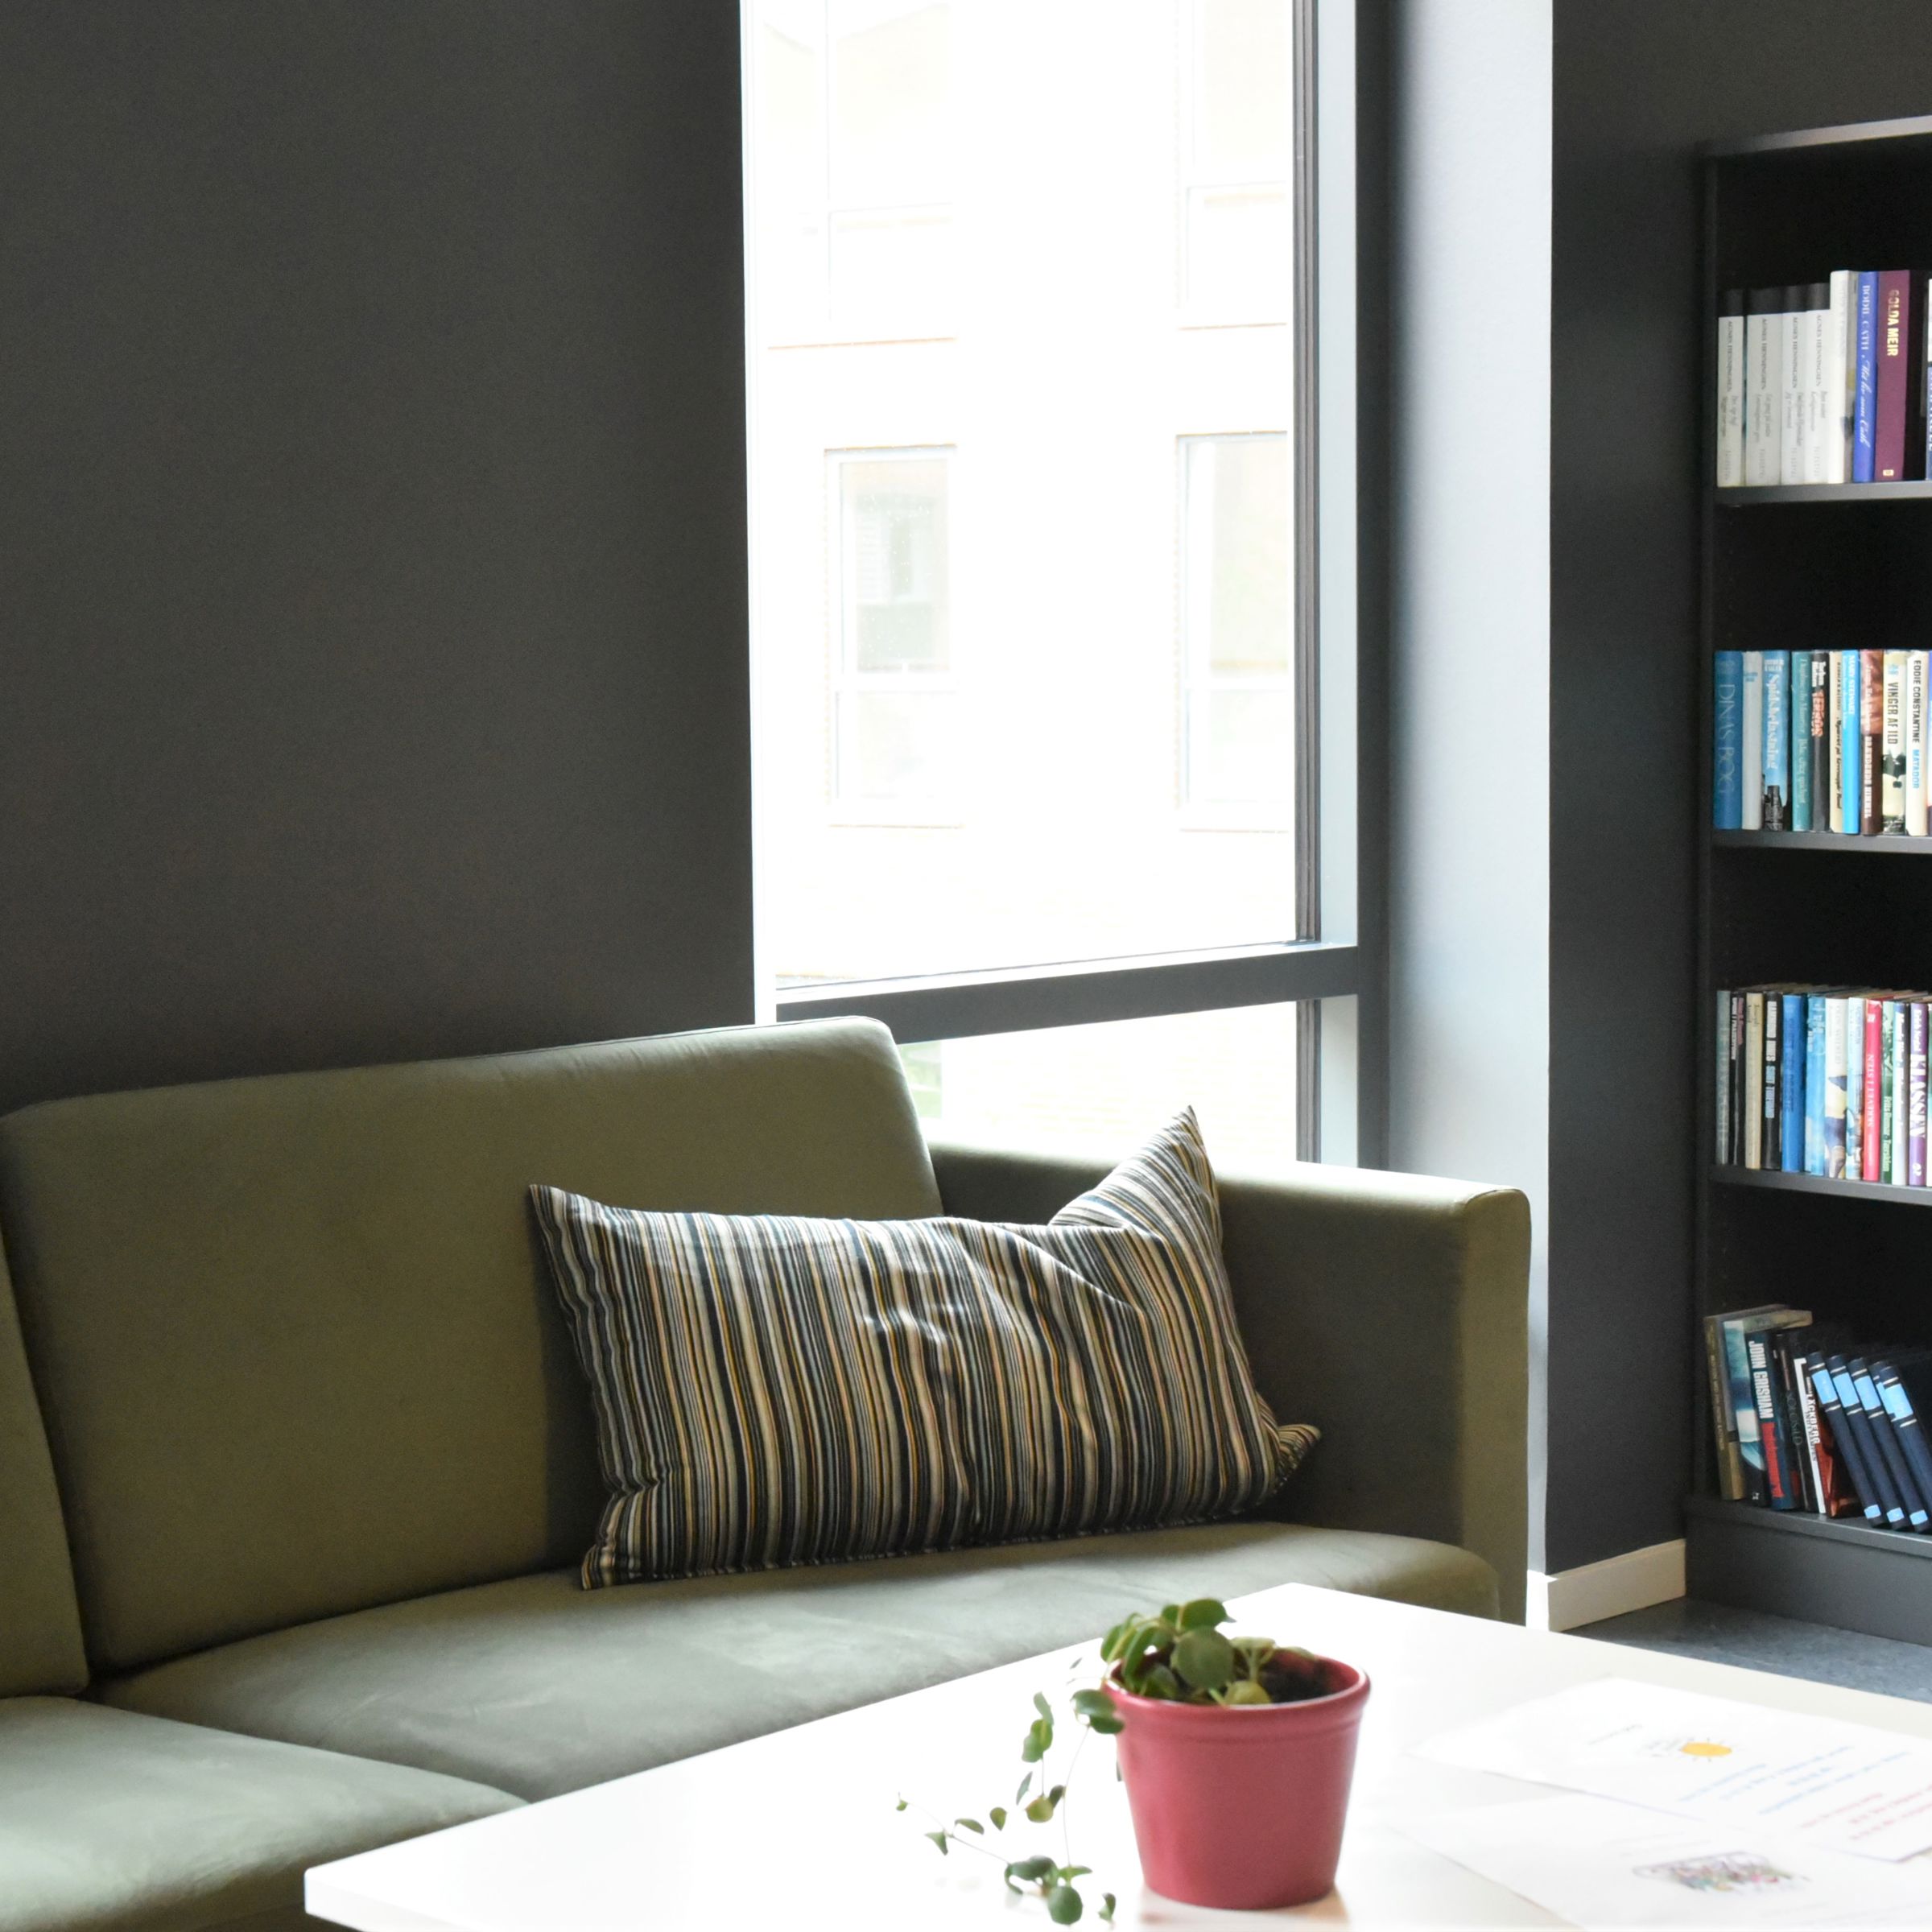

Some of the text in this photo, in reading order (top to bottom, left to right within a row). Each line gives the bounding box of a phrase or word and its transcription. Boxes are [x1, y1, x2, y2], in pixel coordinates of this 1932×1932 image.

[1860, 320, 1870, 350] CATH
[1887, 289, 1900, 357] GOLDA MEIR
[1888, 682, 1899, 715] VINGER
[1888, 717, 1898, 728] AF
[1888, 730, 1898, 745] ILD
[1911, 660, 1922, 789] EDDIE CONSTANTINE MATADOR
[1867, 1054, 1875, 1079] STEN
[1867, 1088, 1875, 1128] SKREVET
[1909, 1054, 1926, 1139] KLASSEN
[1748, 1340, 1766, 1368] JOHN
[1752, 1371, 1774, 1419] GRISHAM
